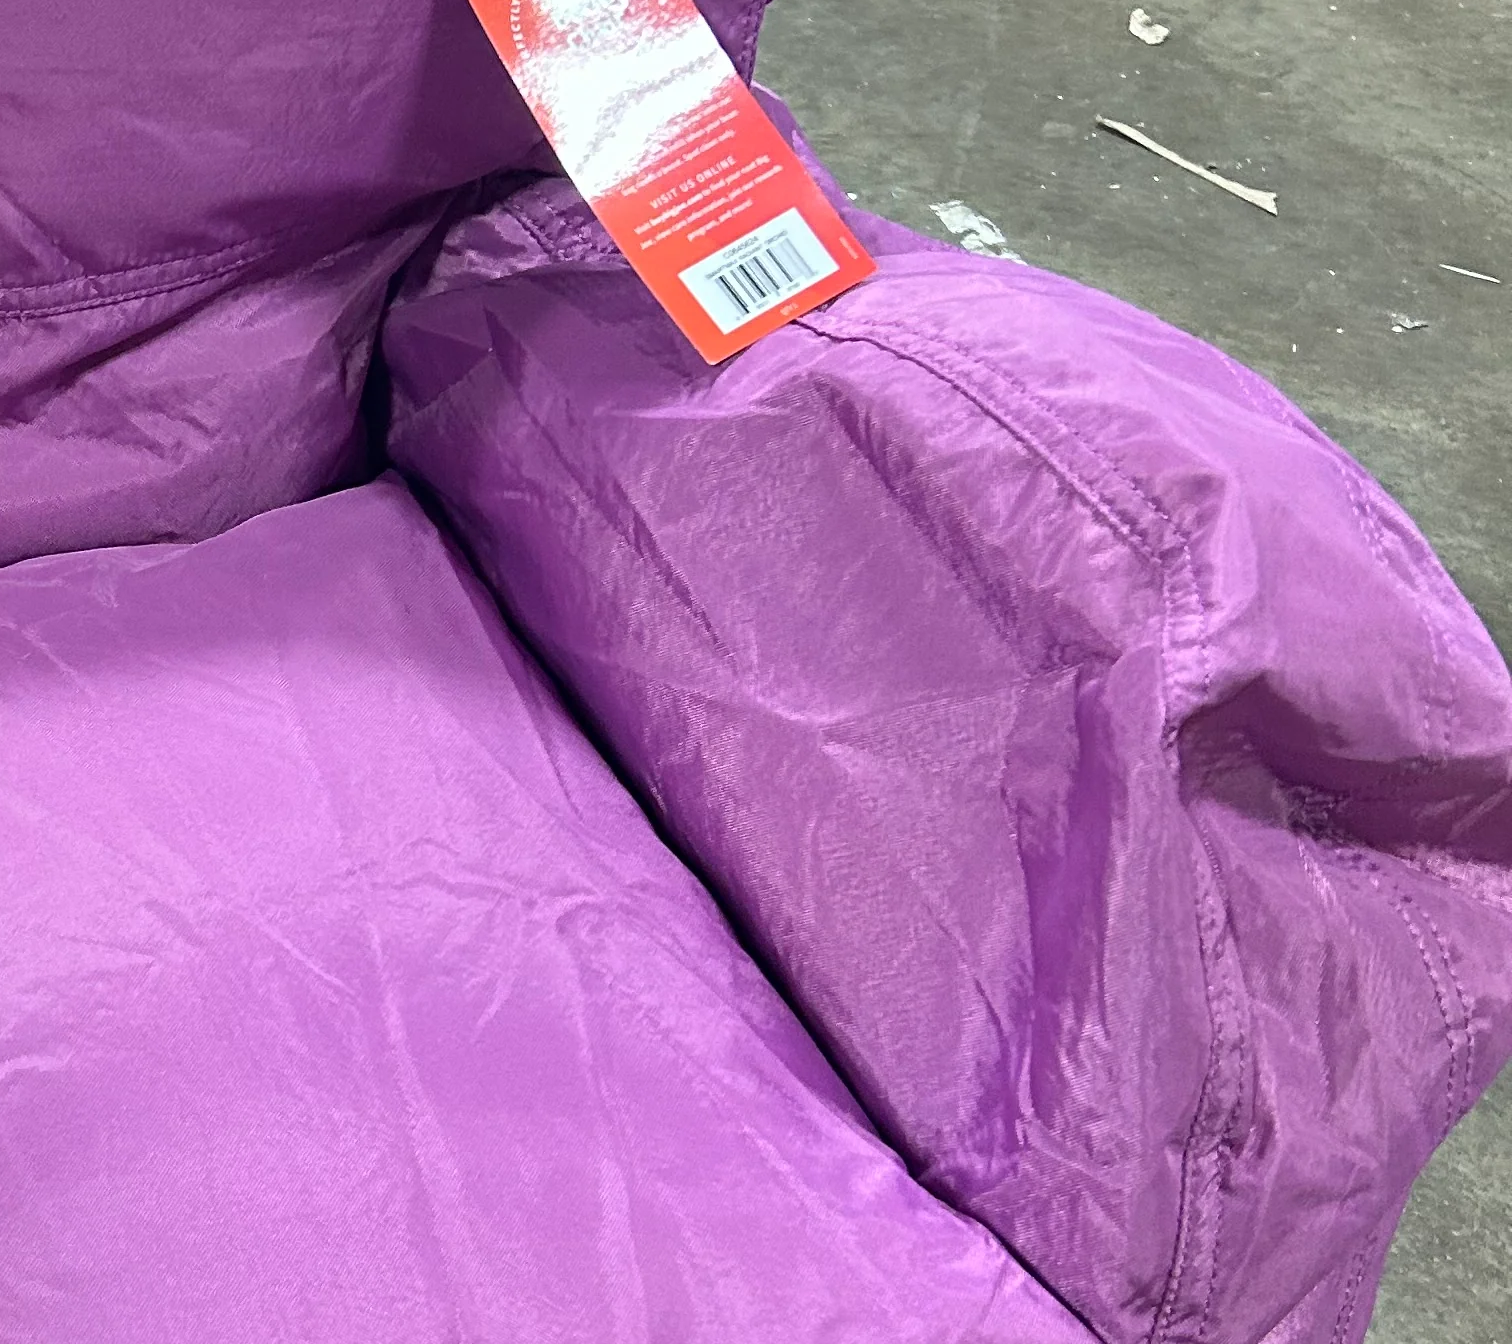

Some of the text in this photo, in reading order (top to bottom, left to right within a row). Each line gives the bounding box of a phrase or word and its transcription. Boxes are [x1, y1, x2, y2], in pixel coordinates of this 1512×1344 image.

[649, 187, 679, 210] VISIT
[678, 177, 696, 193] US
[694, 154, 736, 184] ONLINE
